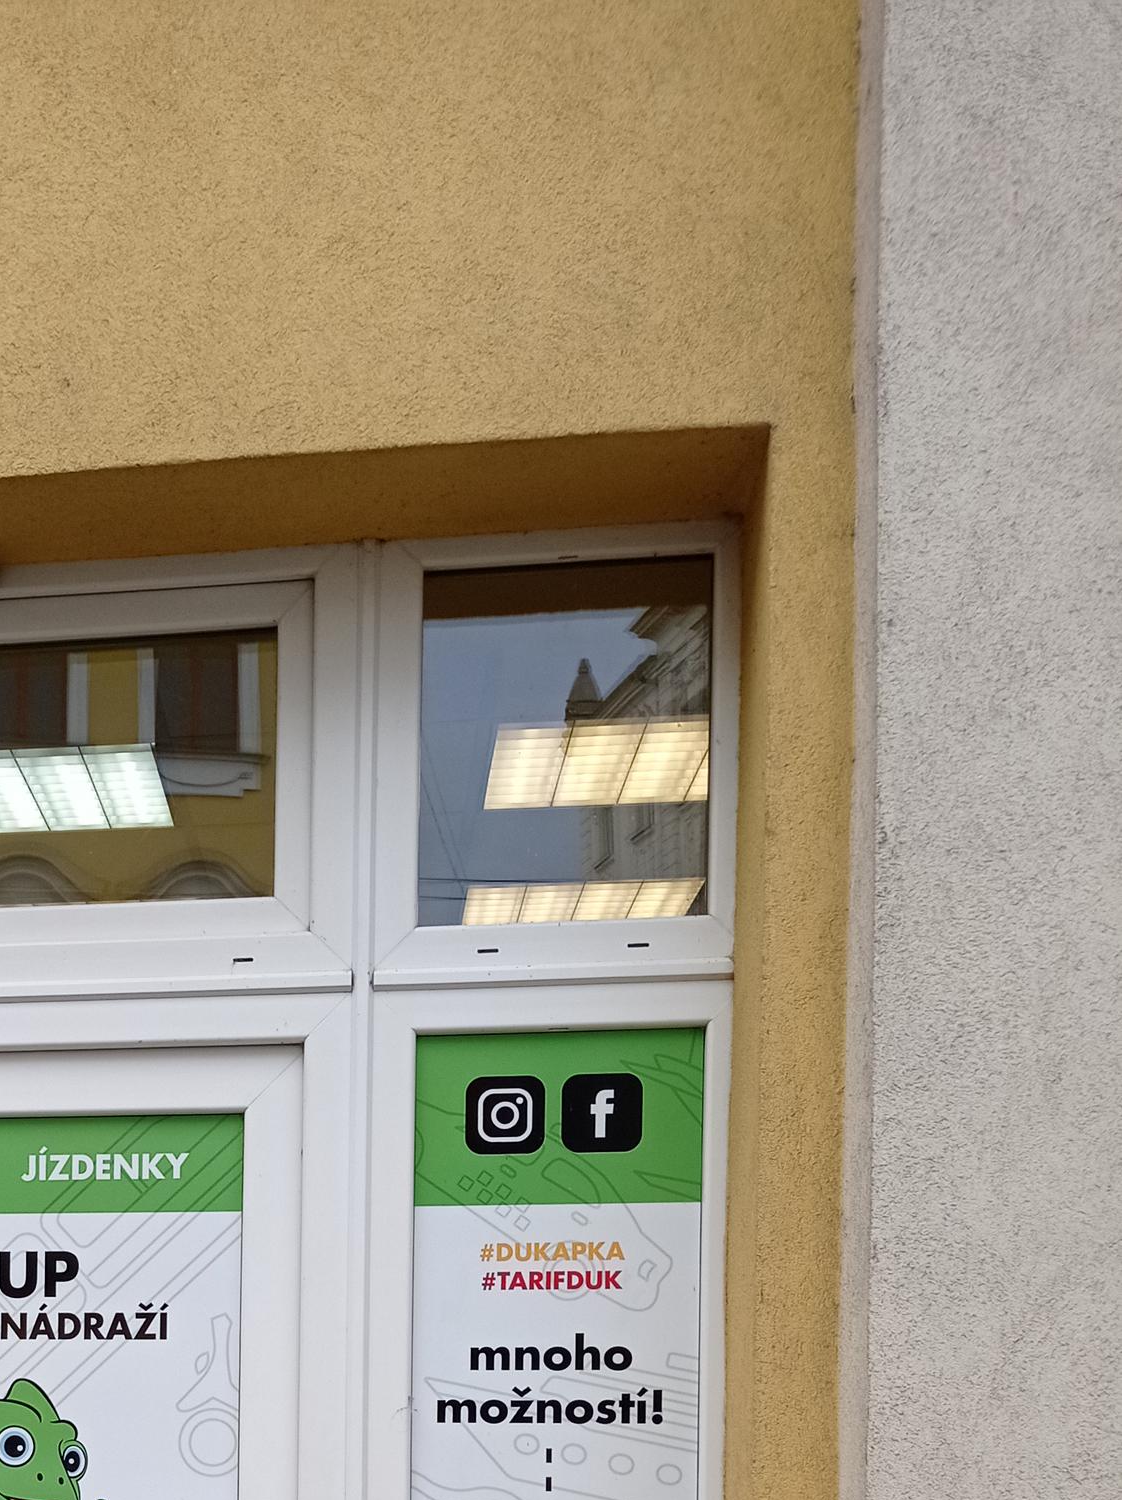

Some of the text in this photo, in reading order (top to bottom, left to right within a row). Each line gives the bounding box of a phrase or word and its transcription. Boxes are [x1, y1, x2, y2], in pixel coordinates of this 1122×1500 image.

[590, 1089, 614, 1138] f
[21, 1146, 189, 1182] JÍZDENKY
[480, 1241, 625, 1262] #DUKAPKA
[482, 1271, 622, 1290] #TARIFDUK
[0, 1303, 169, 1340] NÁDRAŽÍ
[470, 1333, 632, 1370] mnoho
[437, 1387, 662, 1424] možností!
